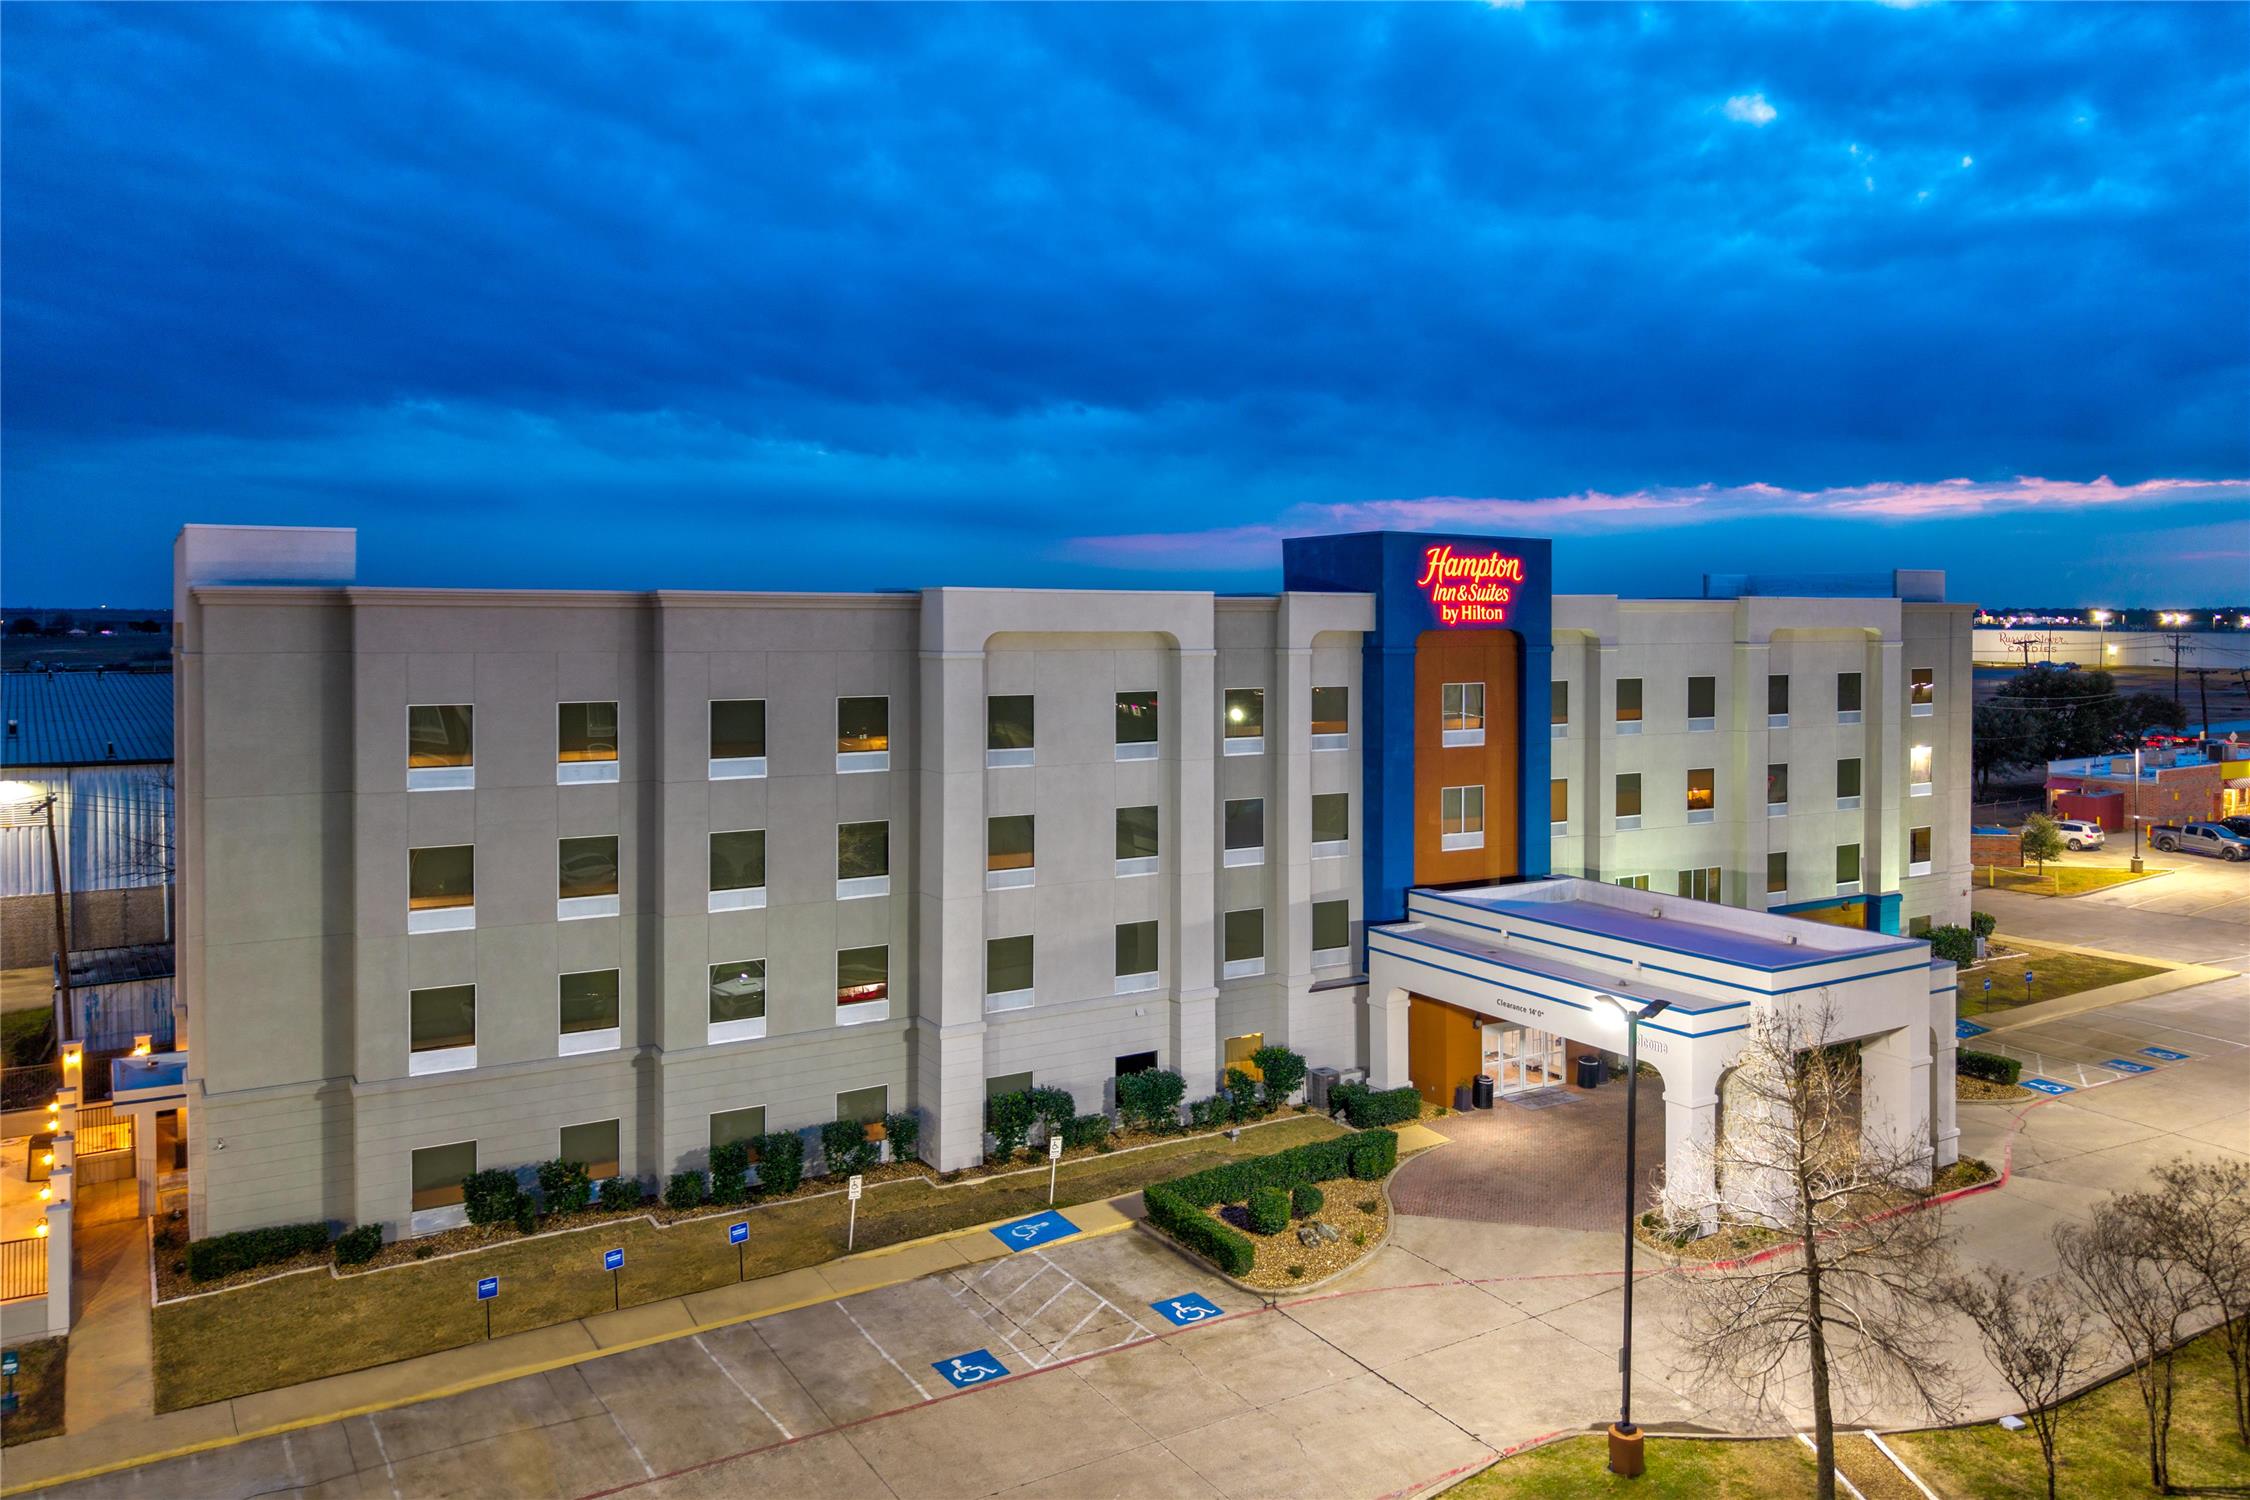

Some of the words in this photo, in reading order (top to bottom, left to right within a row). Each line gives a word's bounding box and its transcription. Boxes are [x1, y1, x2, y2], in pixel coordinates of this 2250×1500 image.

[1417, 545, 1523, 585] Hampton
[1442, 604, 1459, 625] by
[1461, 605, 1503, 620] Hilton
[1496, 998, 1527, 1013] Clearance
